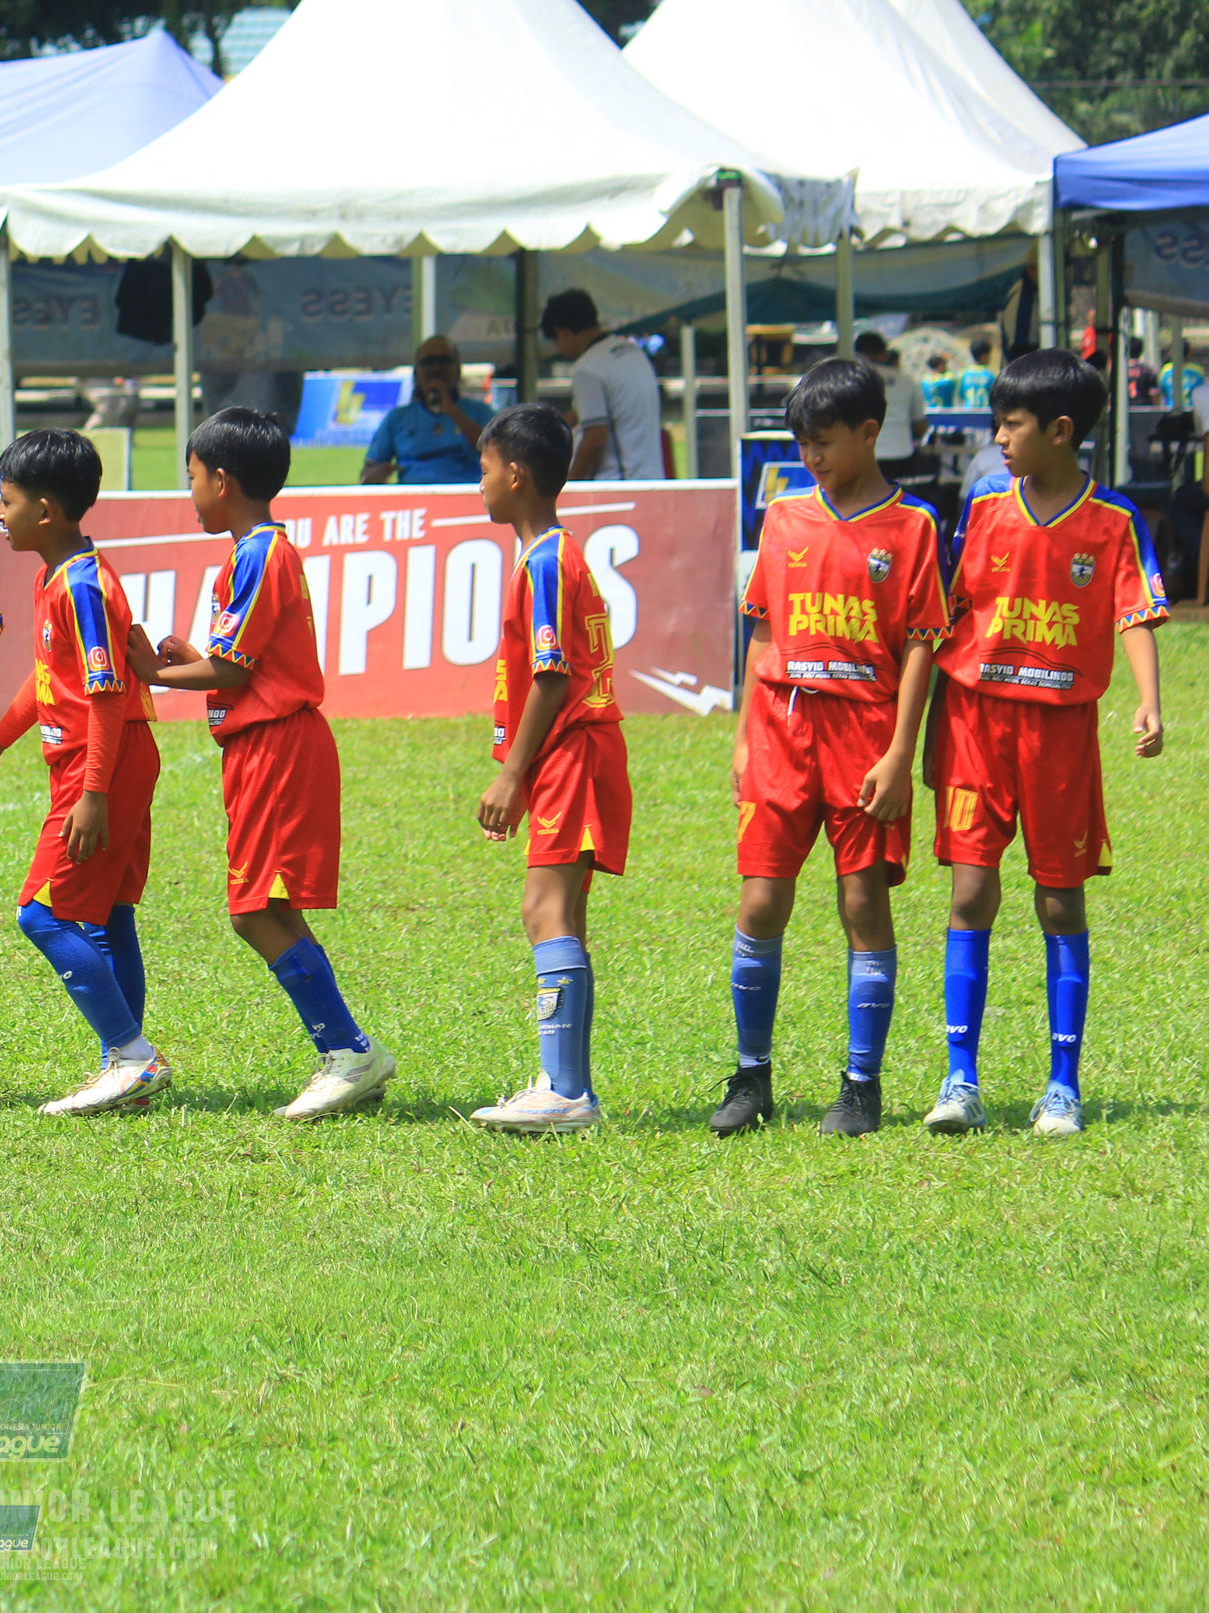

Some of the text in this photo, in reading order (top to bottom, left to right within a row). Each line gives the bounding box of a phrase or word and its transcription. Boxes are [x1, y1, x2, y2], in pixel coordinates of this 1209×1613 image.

[322, 512, 371, 548] ARE
[379, 508, 427, 542] THE
[788, 591, 878, 622] TUNAS
[995, 596, 1081, 626] TUNAS
[788, 613, 880, 644] PRIMA
[985, 617, 1079, 650] PRIMA
[1018, 666, 1075, 682] MOBILINDO
